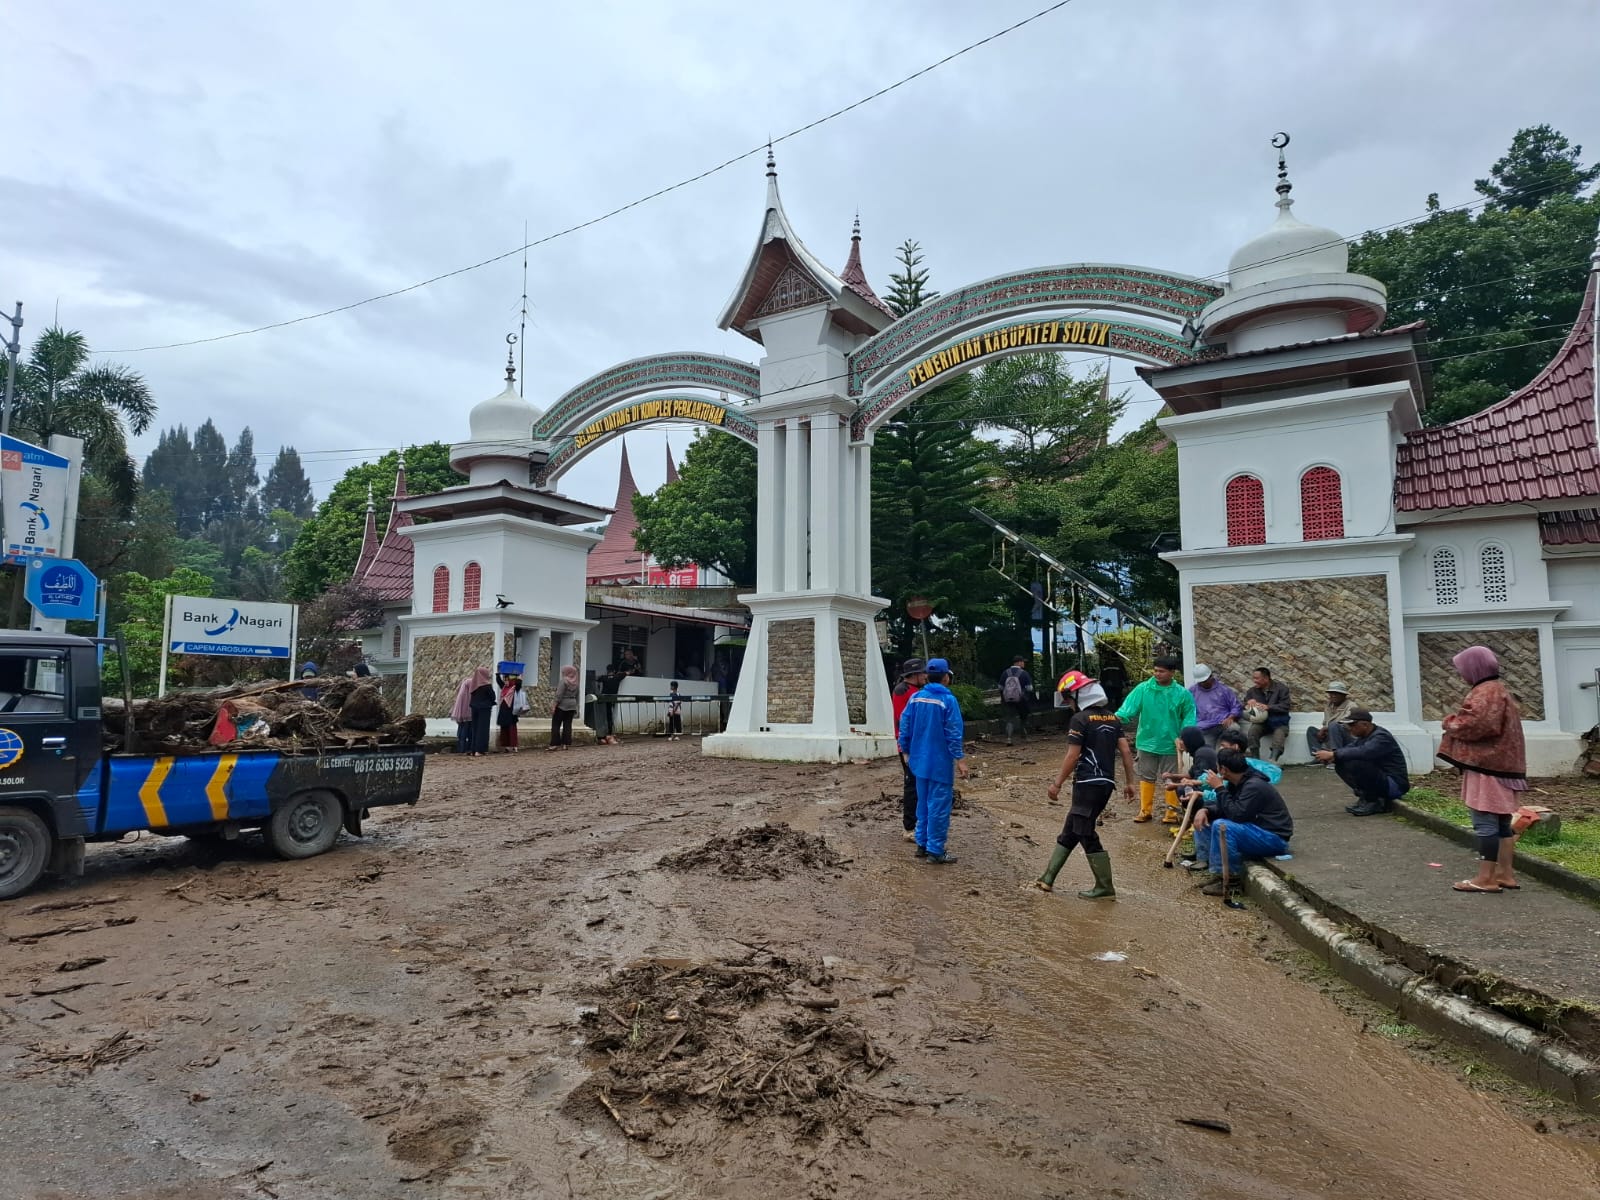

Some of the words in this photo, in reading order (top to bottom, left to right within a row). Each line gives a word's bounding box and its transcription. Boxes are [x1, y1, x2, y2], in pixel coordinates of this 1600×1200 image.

[909, 336, 982, 387] PEMERINTAH
[984, 320, 1059, 353] KABUPATEN
[1062, 321, 1111, 346] SOLOK
[574, 419, 603, 448] SELAMAT
[603, 407, 631, 431] DATANG
[631, 405, 639, 421] DI
[641, 400, 672, 419] KOMPLEK
[673, 400, 726, 425] PERKANTORAN
[3, 452, 19, 463] 24
[23, 452, 44, 462] atm
[29, 467, 43, 501] Nagari
[24, 517, 37, 544] Bank
[183, 611, 219, 624] Bank
[239, 615, 283, 629] Nagari
[187, 643, 216, 652] CAPEM
[216, 645, 254, 654] AROSUKA
[354, 759, 375, 774] 0812
[375, 757, 394, 772] 6363
[395, 757, 414, 770] 5229
